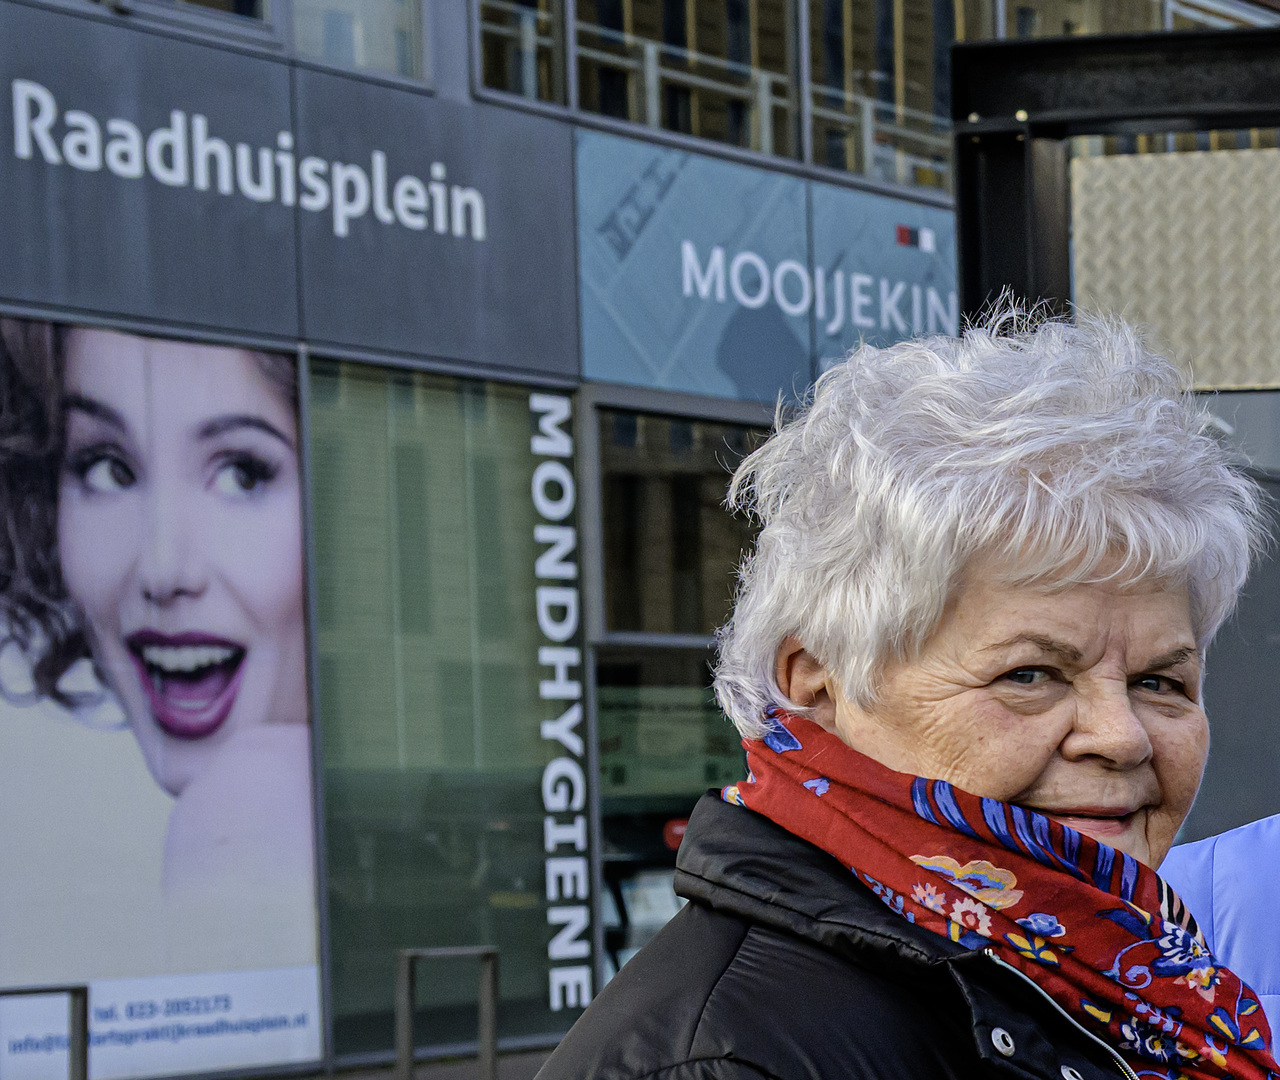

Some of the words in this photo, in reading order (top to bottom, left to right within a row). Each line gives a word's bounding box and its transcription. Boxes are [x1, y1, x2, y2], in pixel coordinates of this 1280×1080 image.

[12, 79, 487, 241] Raadhuisplein
[681, 239, 958, 337] MOOIJEKIN
[529, 393, 594, 1012] MONDHYGIENE
